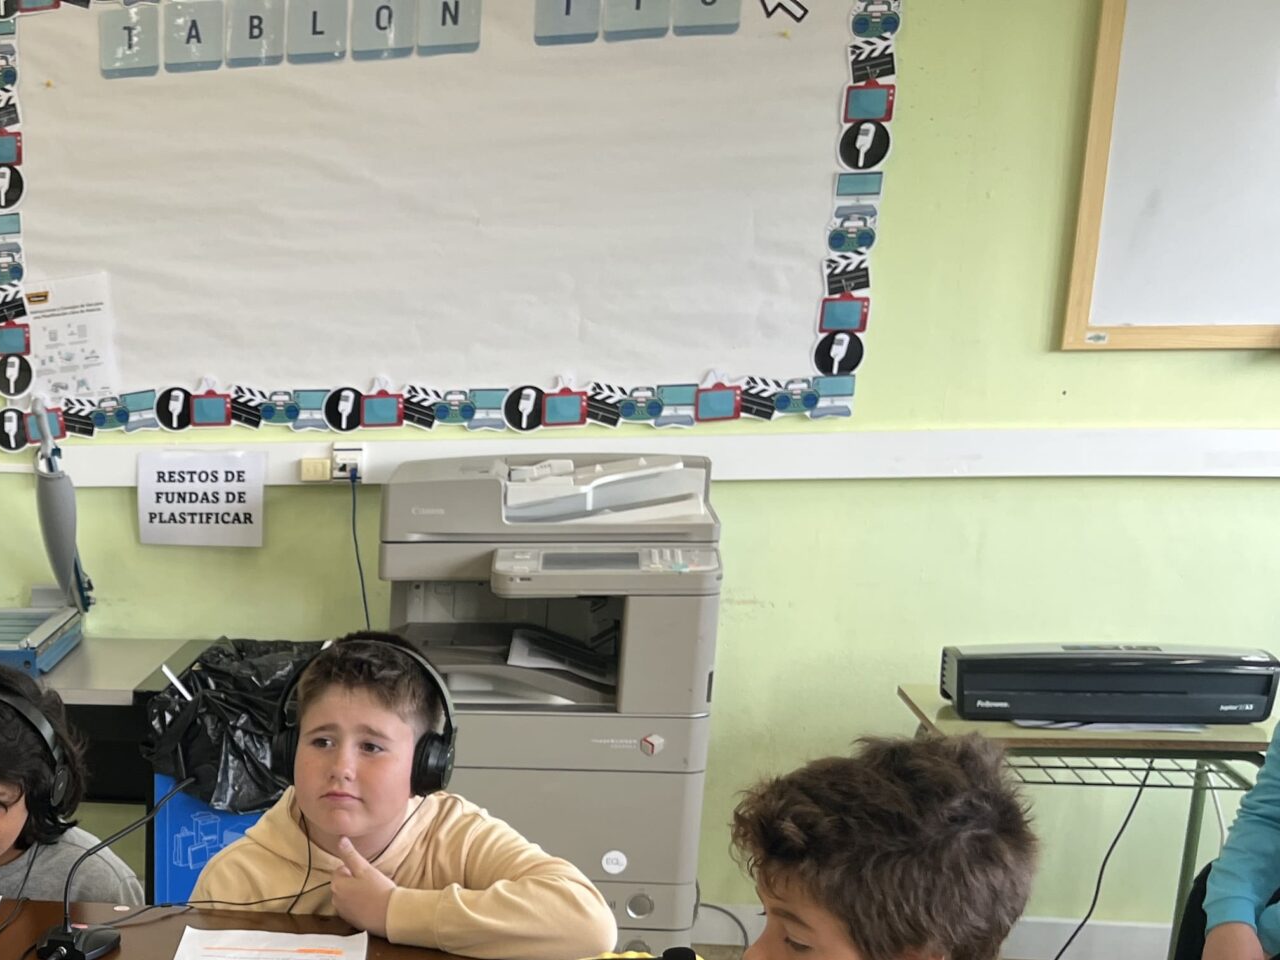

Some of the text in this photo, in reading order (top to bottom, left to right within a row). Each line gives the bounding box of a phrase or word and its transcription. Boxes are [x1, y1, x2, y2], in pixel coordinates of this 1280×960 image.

[156, 470, 246, 483] RESTOS DE
[155, 491, 247, 504] FUNDAS DE
[148, 512, 254, 525] PLASTIFICAR
